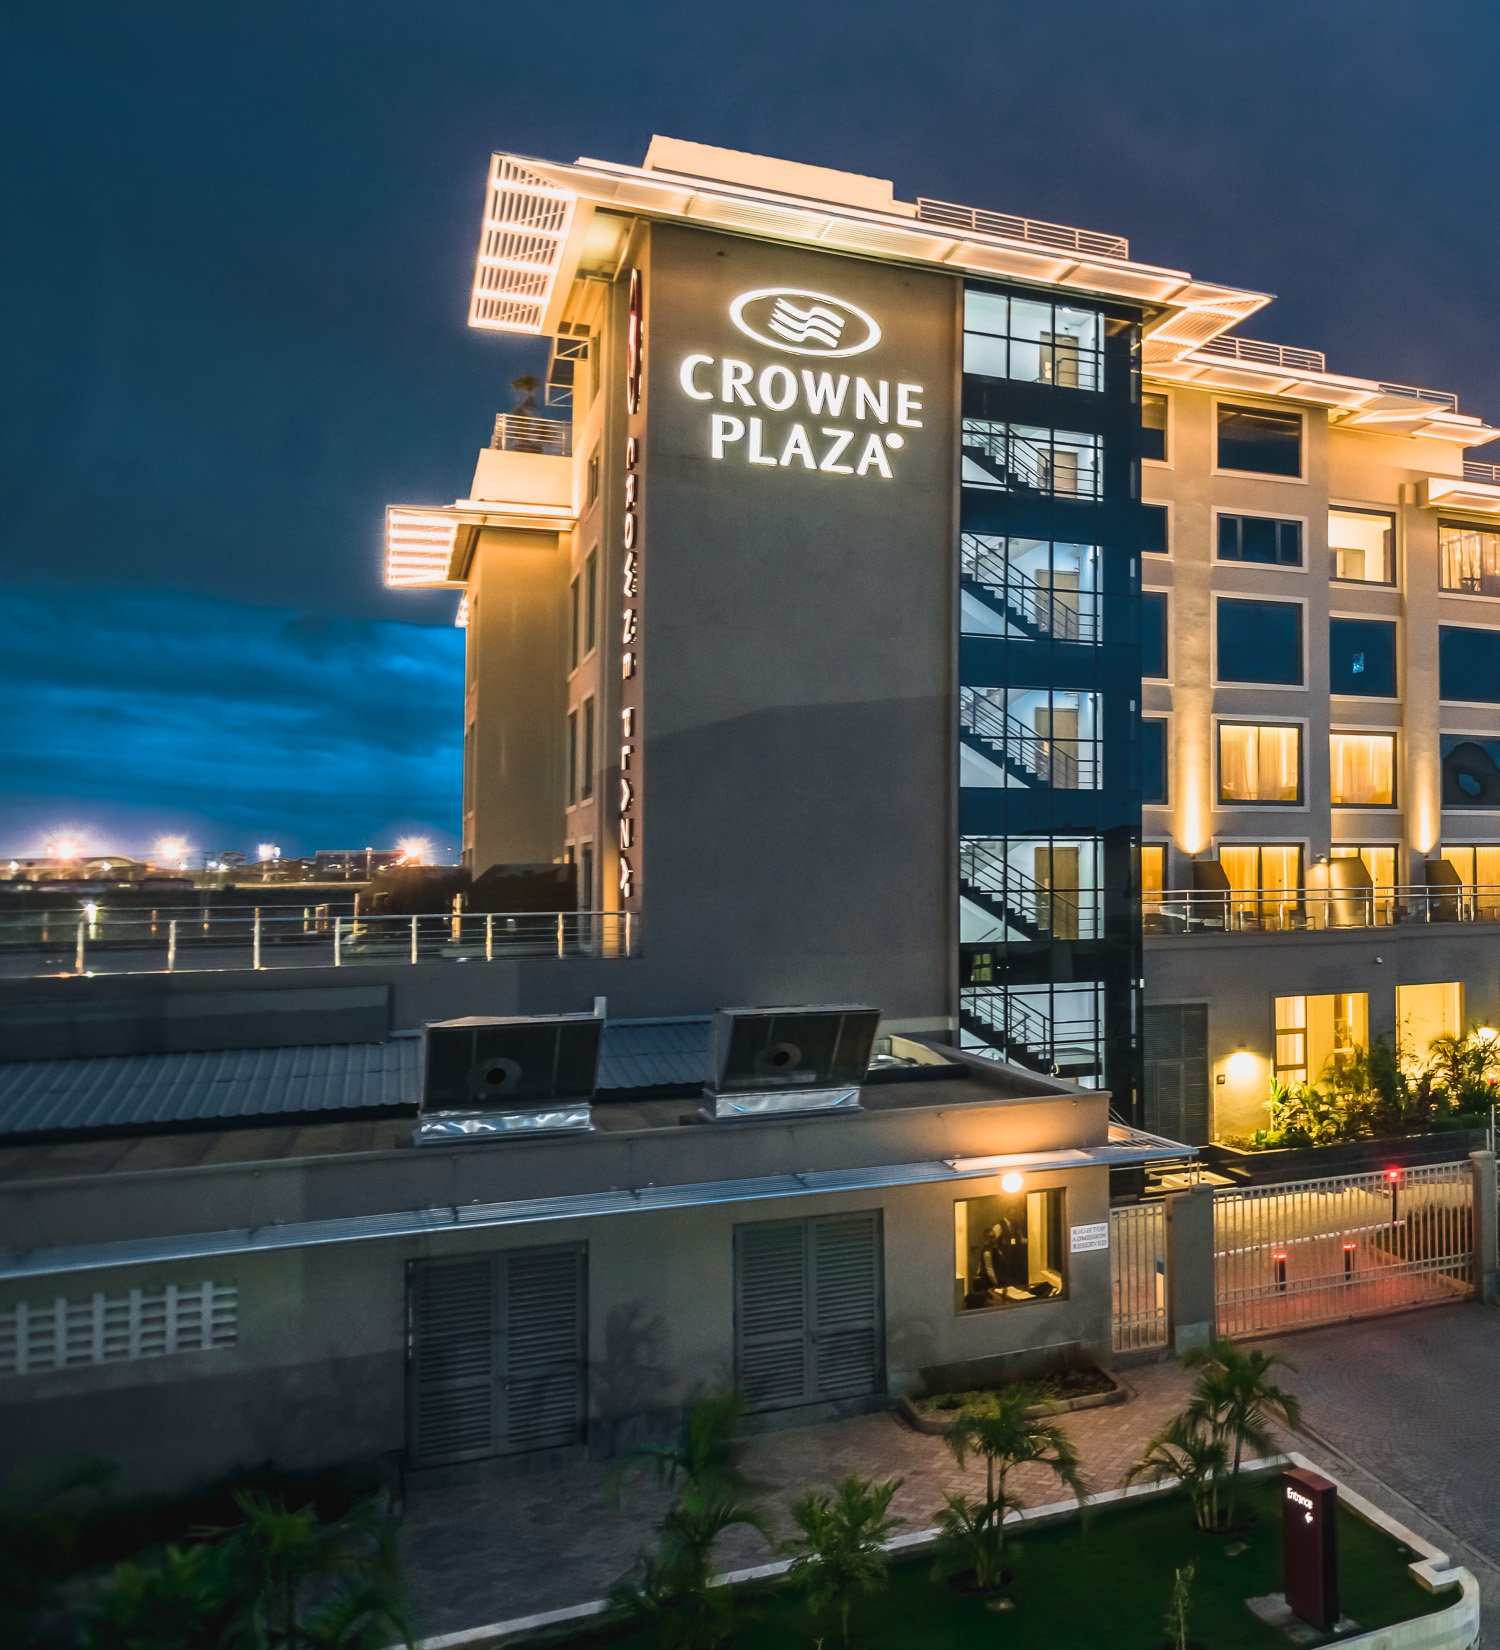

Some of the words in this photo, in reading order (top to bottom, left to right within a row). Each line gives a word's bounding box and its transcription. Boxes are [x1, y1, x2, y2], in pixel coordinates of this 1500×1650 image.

[679, 354, 924, 428] CROWNE
[711, 414, 894, 479] PLAZA
[1072, 1240, 1106, 1249] RESERVED
[1286, 1486, 1313, 1510] Entrance
